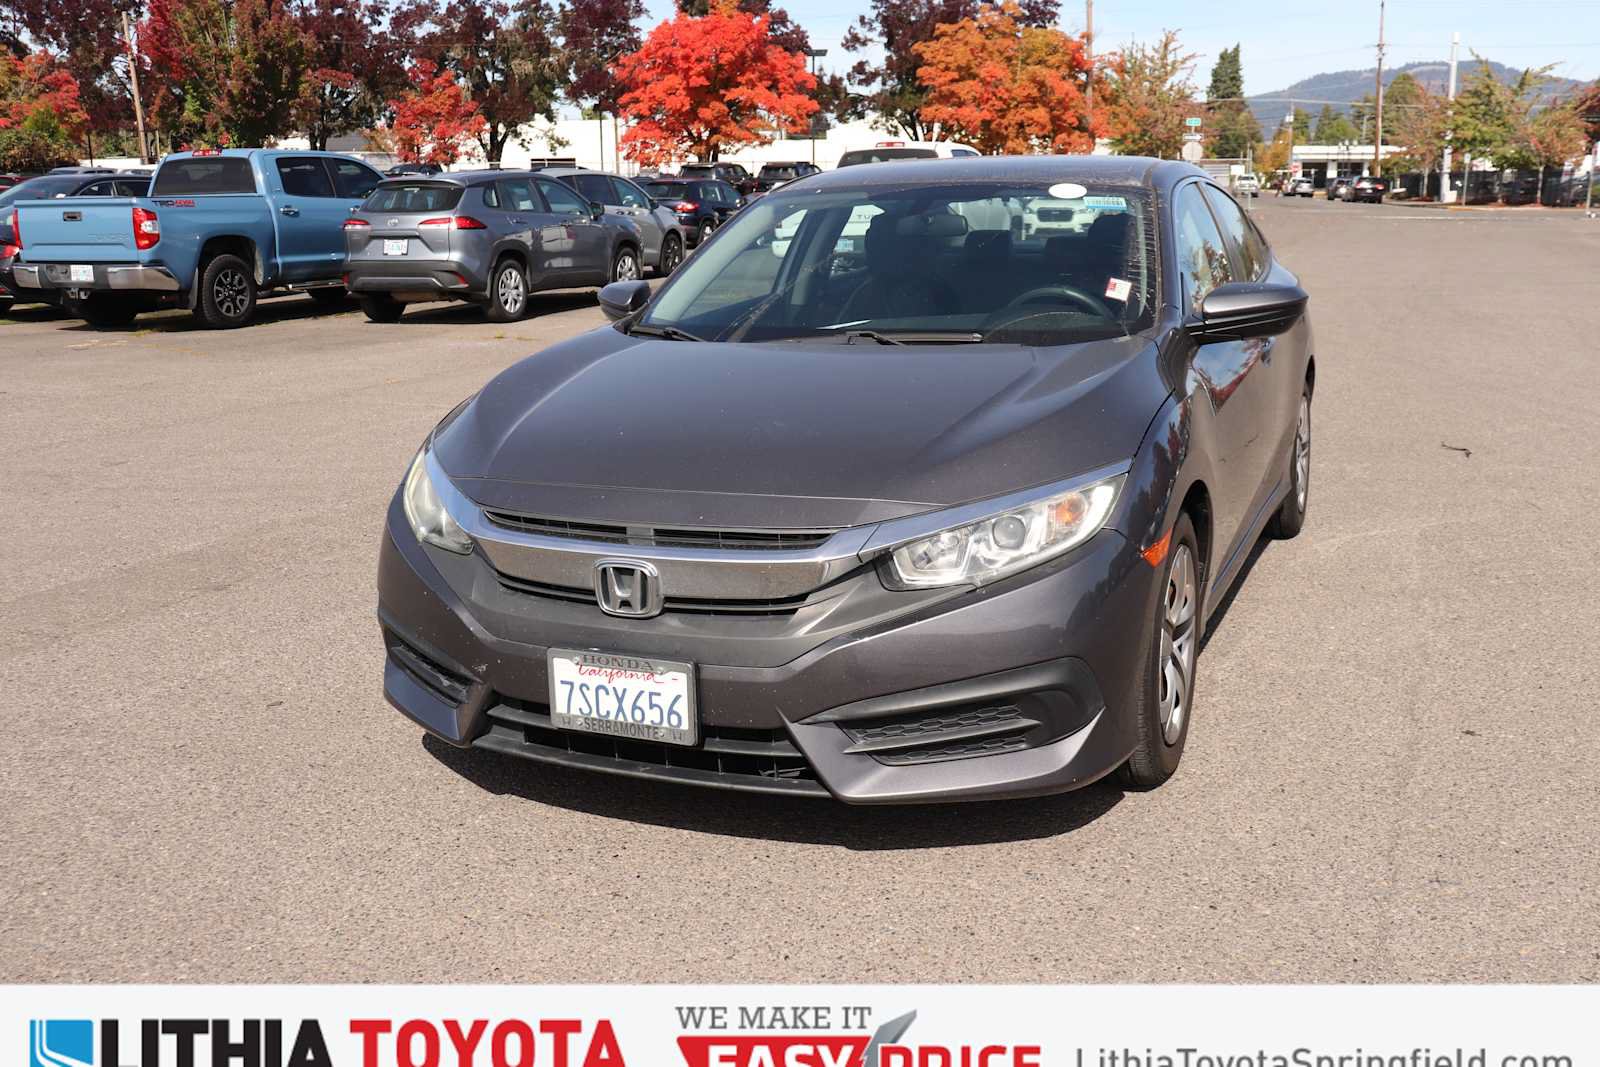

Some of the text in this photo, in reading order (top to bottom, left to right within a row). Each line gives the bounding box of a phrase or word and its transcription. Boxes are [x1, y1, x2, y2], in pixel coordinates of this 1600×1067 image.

[583, 654, 654, 671] HONDA
[560, 680, 683, 729] 7SCX656
[584, 716, 660, 740] SERRAMONTE
